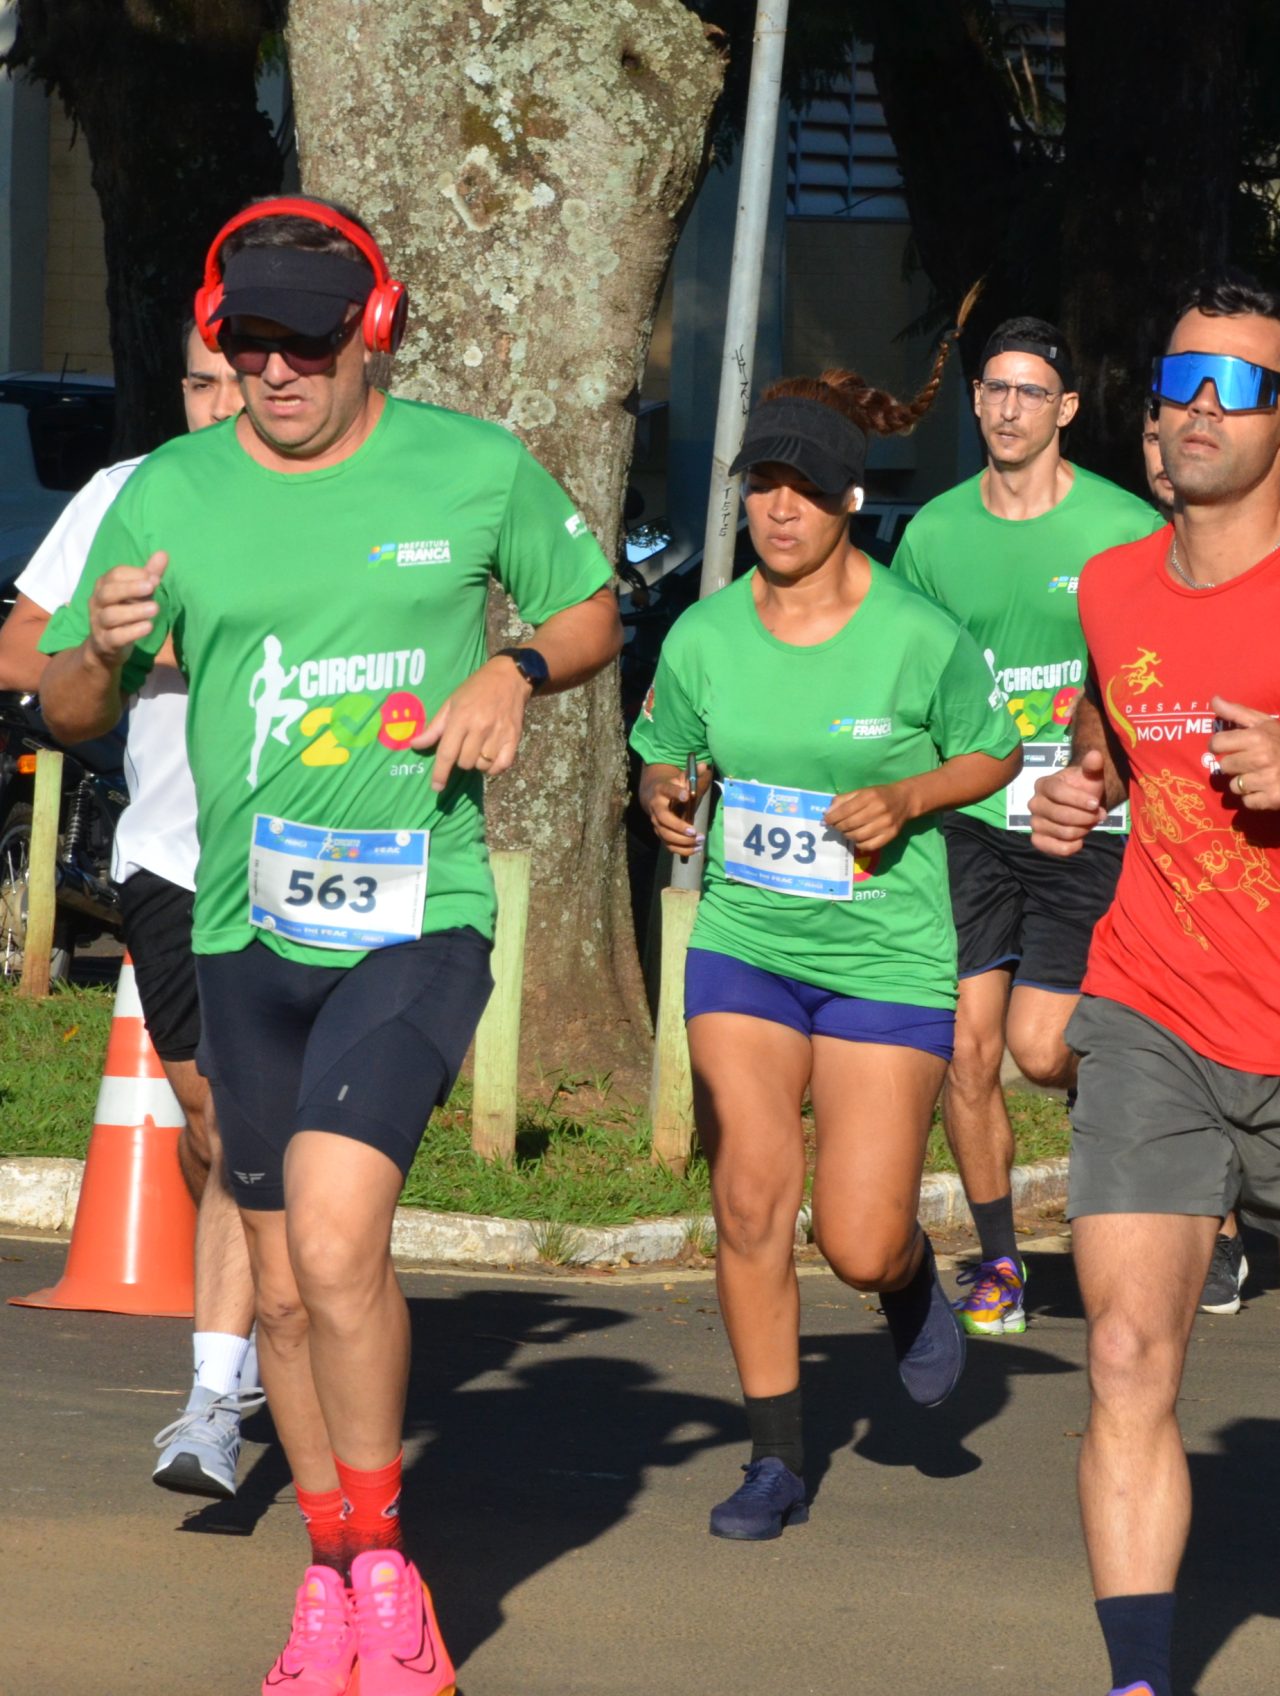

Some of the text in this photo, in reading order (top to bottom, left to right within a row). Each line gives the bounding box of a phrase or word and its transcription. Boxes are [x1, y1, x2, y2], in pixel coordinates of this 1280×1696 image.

[397, 548, 451, 563] FRANCA
[398, 540, 450, 550] PREFEITURA
[299, 648, 426, 698] CIRCUITO
[1003, 659, 1082, 692] CIRCUITO
[743, 823, 817, 864] 493
[285, 869, 378, 913] 563
[855, 888, 887, 901] anos
